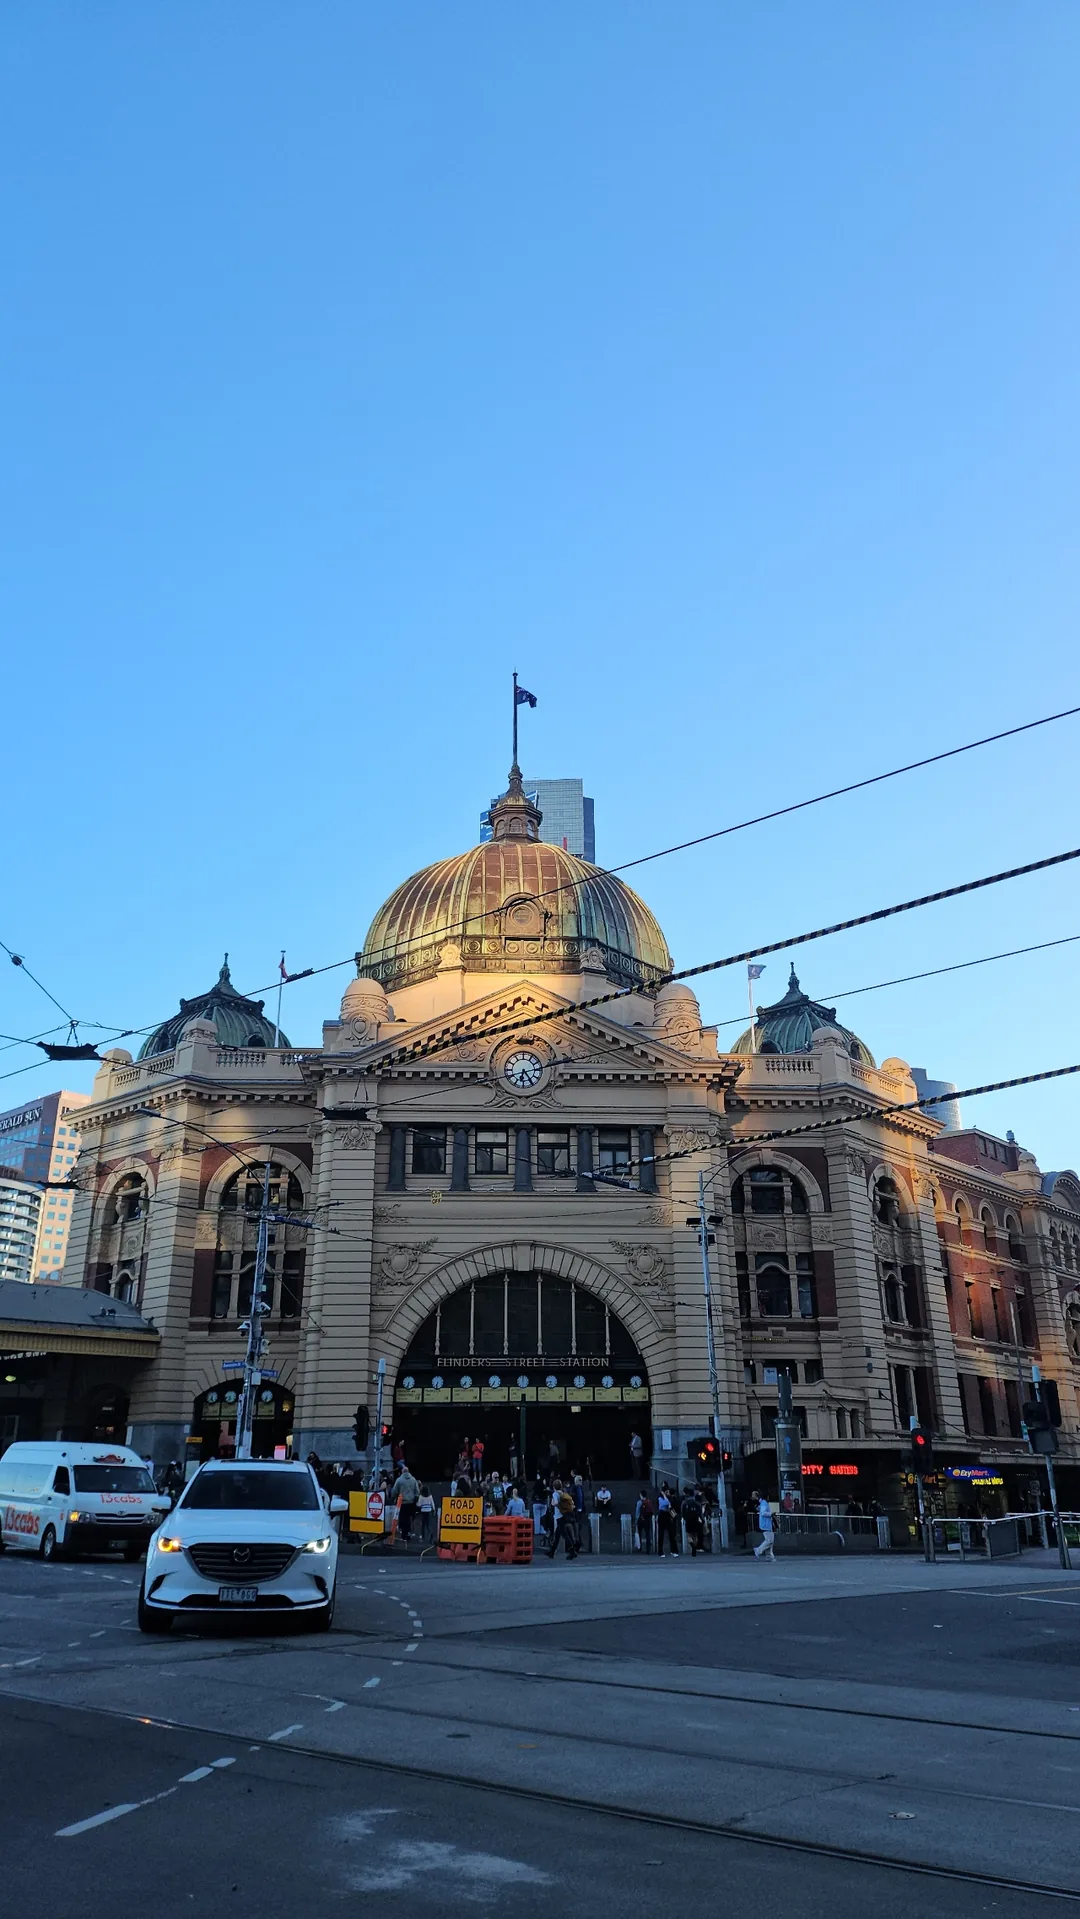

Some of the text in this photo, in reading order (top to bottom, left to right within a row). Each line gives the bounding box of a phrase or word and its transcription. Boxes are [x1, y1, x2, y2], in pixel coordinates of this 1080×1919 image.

[437, 1357, 609, 1367] FLINDERS STREET STATION
[801, 1464, 823, 1475] CITY
[100, 1493, 142, 1504] 13cabs
[450, 1499, 474, 1510] ROAD
[4, 1504, 40, 1535] 13cabs
[444, 1513, 479, 1525] CLOSED
